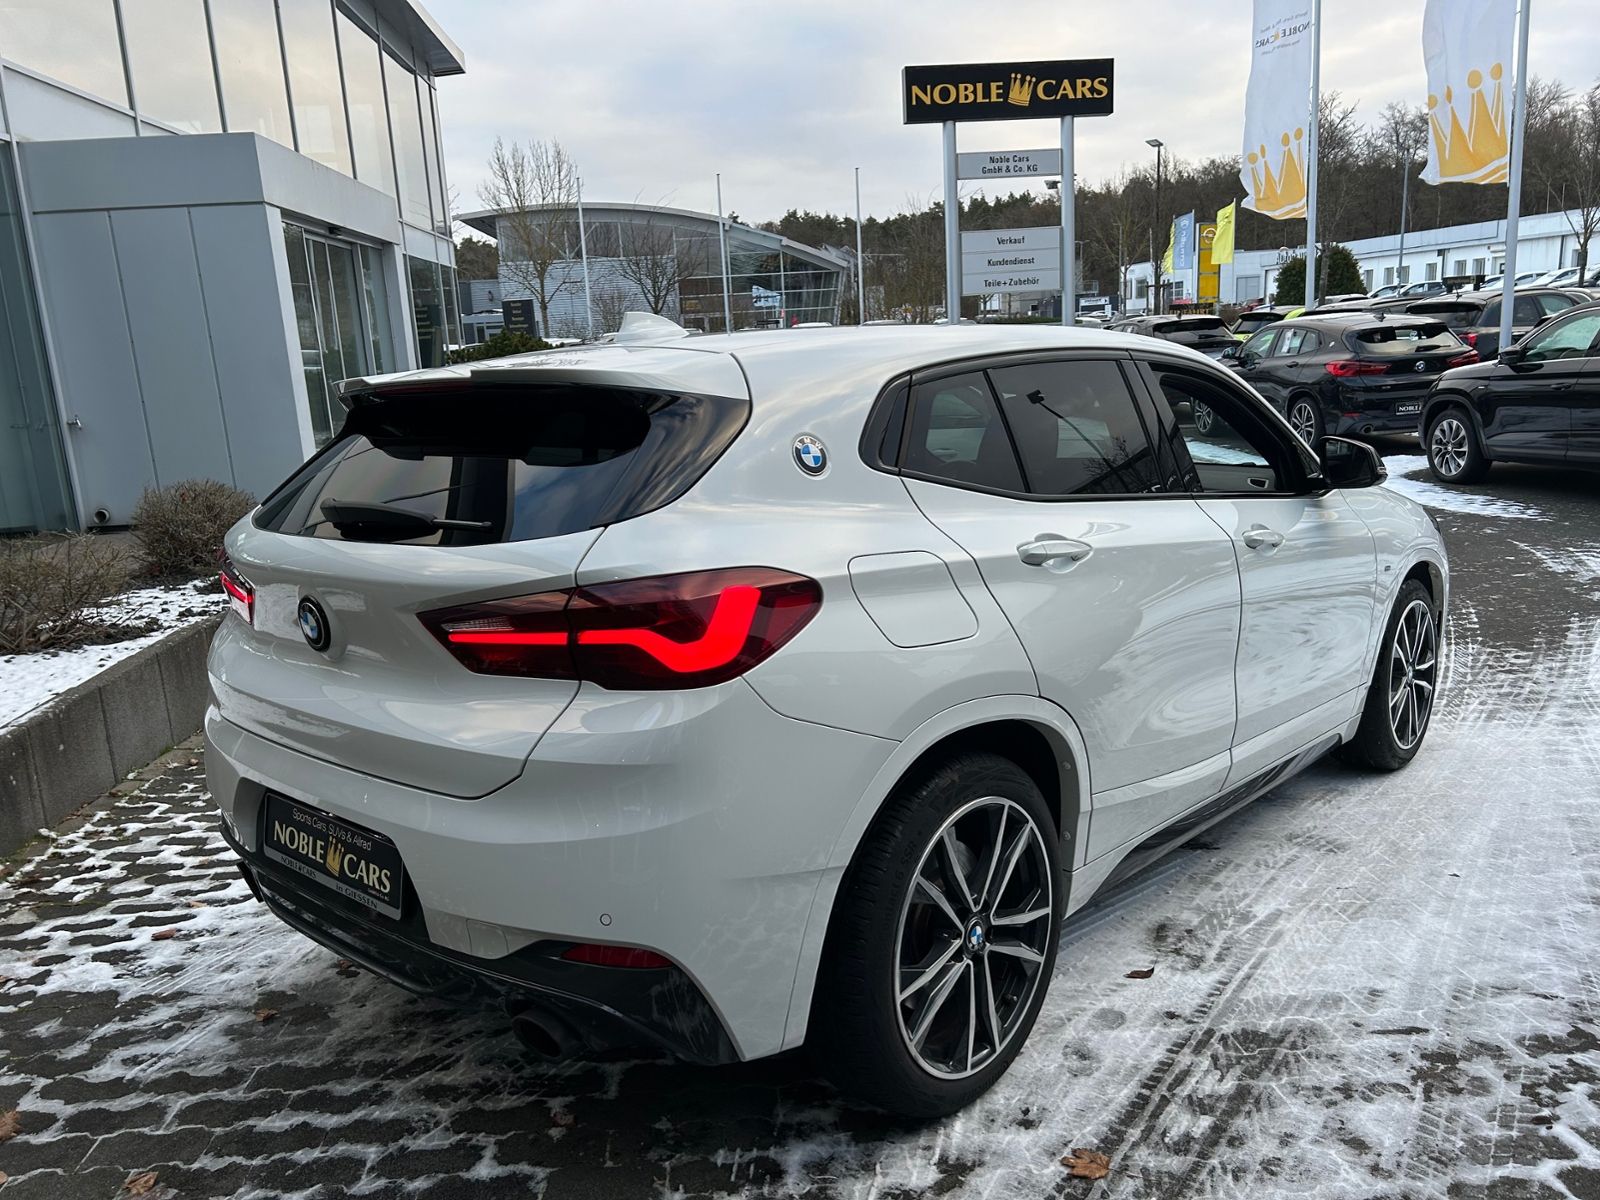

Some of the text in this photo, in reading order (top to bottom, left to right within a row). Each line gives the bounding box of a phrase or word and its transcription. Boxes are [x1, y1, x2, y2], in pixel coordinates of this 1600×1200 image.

[911, 77, 1109, 106] NOBLE CARS
[989, 154, 1030, 164] Noble Cars
[981, 163, 1038, 175] GmbH & Co. KG
[996, 235, 1025, 245] Verkauf
[987, 256, 1035, 267] Kundendienst
[983, 277, 1040, 288] Teile+Zubehör
[292, 808, 312, 825] Sports
[312, 817, 327, 832] Cars
[329, 823, 346, 840] SUVs
[273, 820, 391, 893] NOBLE CARS
